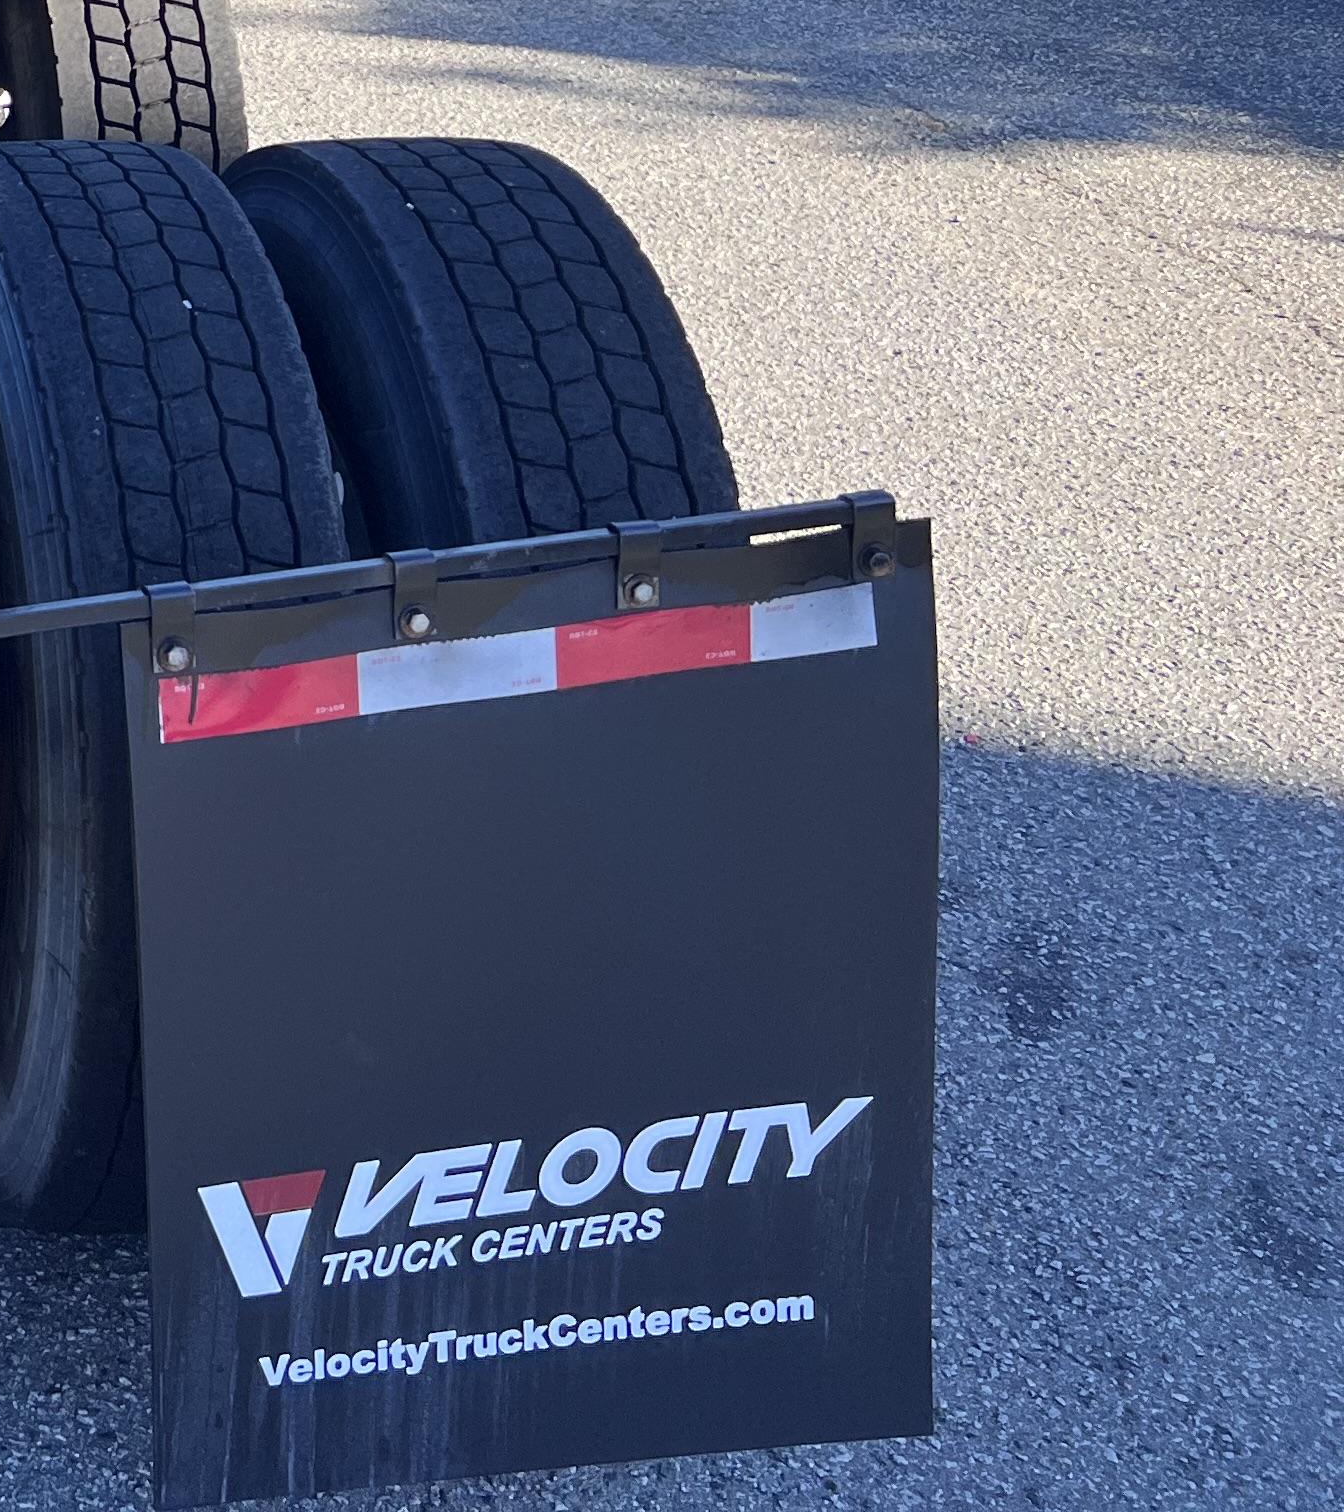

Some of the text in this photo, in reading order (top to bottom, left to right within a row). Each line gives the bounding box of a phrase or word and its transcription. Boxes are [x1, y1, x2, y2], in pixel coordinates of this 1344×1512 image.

[334, 1095, 874, 1239] VELOCITY
[320, 1207, 664, 1287] TRUCK CENTERS
[258, 1293, 815, 1388] VelocityTruckCenters.com
